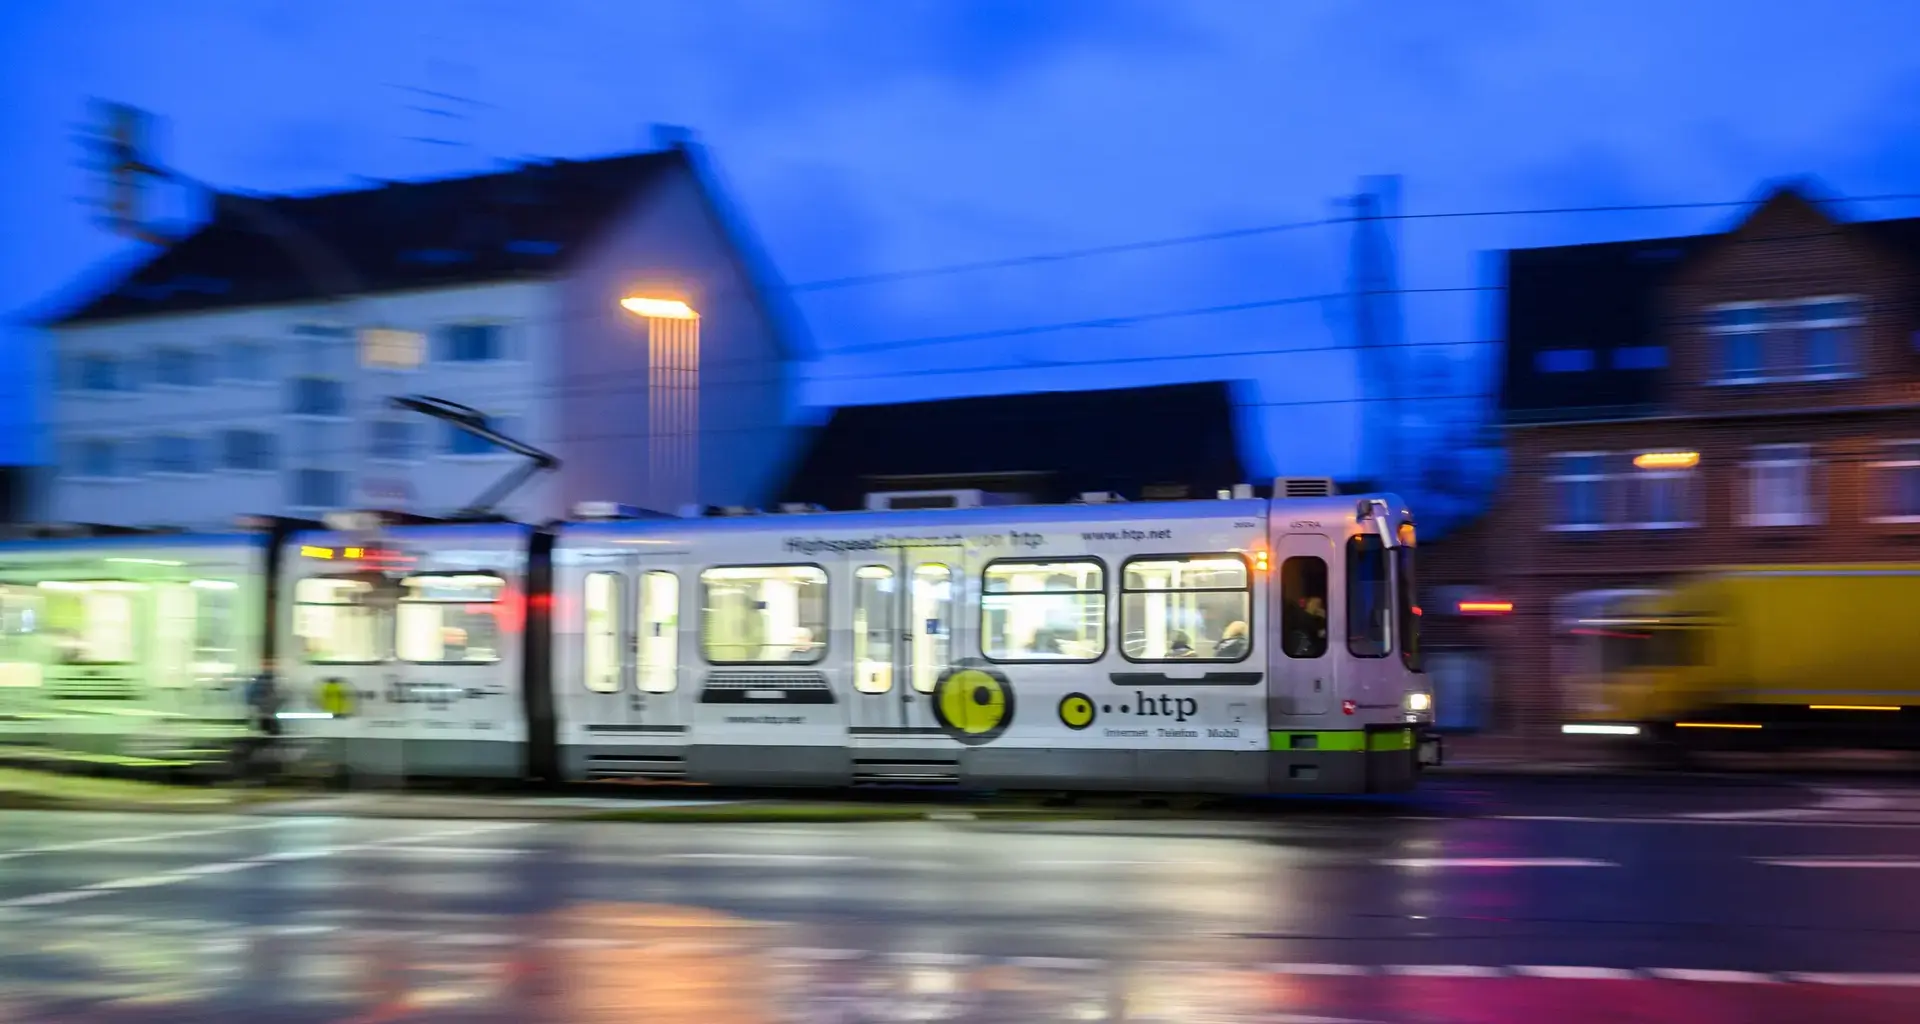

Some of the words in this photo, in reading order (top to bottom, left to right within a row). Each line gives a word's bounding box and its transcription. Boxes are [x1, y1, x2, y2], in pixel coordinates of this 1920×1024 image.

[1081, 528, 1172, 542] www.htp.net
[1135, 690, 1198, 722] htp
[1103, 727, 1149, 738] Internet
[1157, 727, 1198, 738] Telefon
[1207, 727, 1240, 738] Mobil
